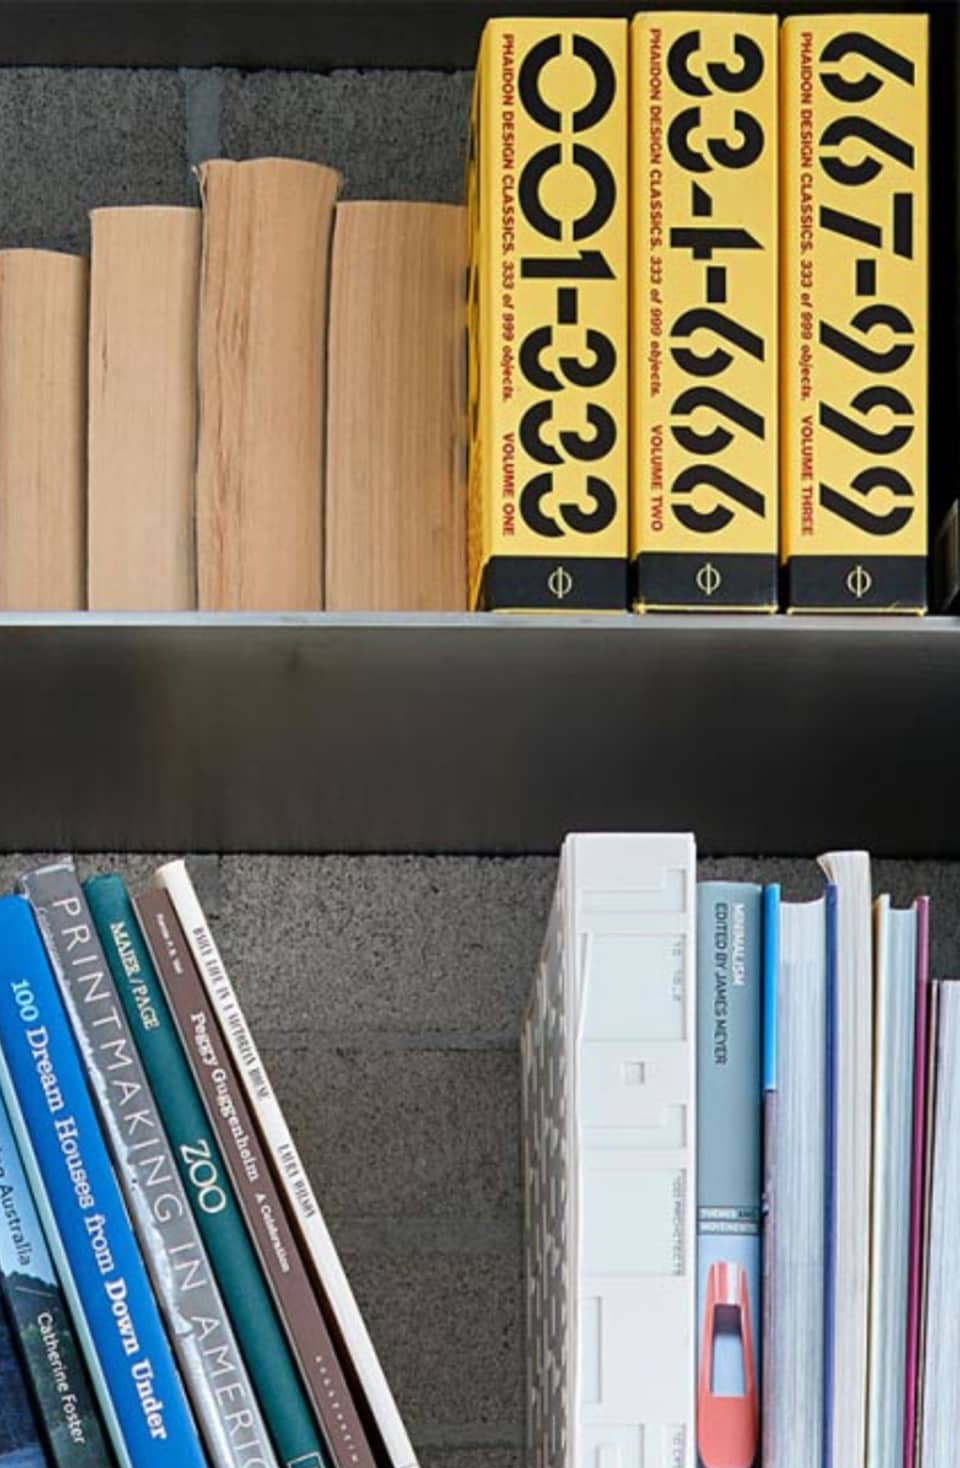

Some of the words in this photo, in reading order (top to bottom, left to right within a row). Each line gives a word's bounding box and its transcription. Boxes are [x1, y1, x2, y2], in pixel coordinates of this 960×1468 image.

[502, 34, 515, 105] PHAIDON
[650, 28, 662, 101] PHAIDON
[801, 32, 814, 105] PHAIDON
[502, 110, 515, 170] DESIGN
[650, 105, 662, 165] DESIGN
[801, 109, 814, 167] DESIGN
[502, 174, 515, 255] CLASSICS.
[650, 169, 662, 250] CLASSICS.
[801, 172, 814, 254] CLASSICS.
[502, 261, 515, 289] 333
[518, 33, 618, 538] 001-333
[650, 256, 662, 285] 333
[650, 289, 662, 304] of
[667, 30, 766, 532] 334-666
[801, 260, 814, 289] 333
[818, 32, 915, 537] 667-999
[502, 293, 515, 310] of
[502, 313, 515, 341] 999
[650, 308, 662, 337] 999
[801, 293, 814, 309] of
[801, 312, 814, 341] 999
[500, 345, 515, 403] objects.
[648, 341, 662, 398] objects.
[799, 344, 814, 402] objects.
[502, 432, 515, 498] VOLUME
[650, 425, 662, 491] VOLUME
[801, 415, 814, 481] VOLUME
[502, 502, 515, 537] ONE
[650, 495, 662, 532] TWO
[801, 485, 814, 536] THREE
[714, 902, 728, 951] EDITED
[732, 902, 745, 986] MINIMALISM
[714, 952, 728, 970] BY
[7, 975, 42, 1025] 100
[714, 972, 728, 1017] JAMES
[22, 1024, 69, 1113] Dream
[714, 1019, 728, 1066] MEYER
[51, 892, 186, 1226] PRINTMAKING
[164, 1239, 208, 1293] IN
[182, 1009, 222, 1069] Peggy
[203, 1064, 264, 1185] Guggenheim
[49, 1111, 99, 1211] Houses
[178, 1136, 230, 1218] ZOO
[254, 1190, 268, 1204] A
[80, 1210, 119, 1275] from
[258, 1202, 293, 1274] Celebration
[101, 1275, 145, 1357] Down
[34, 1309, 74, 1393] Catherine
[57, 1392, 89, 1446] Foster
[126, 1357, 172, 1443] Under
